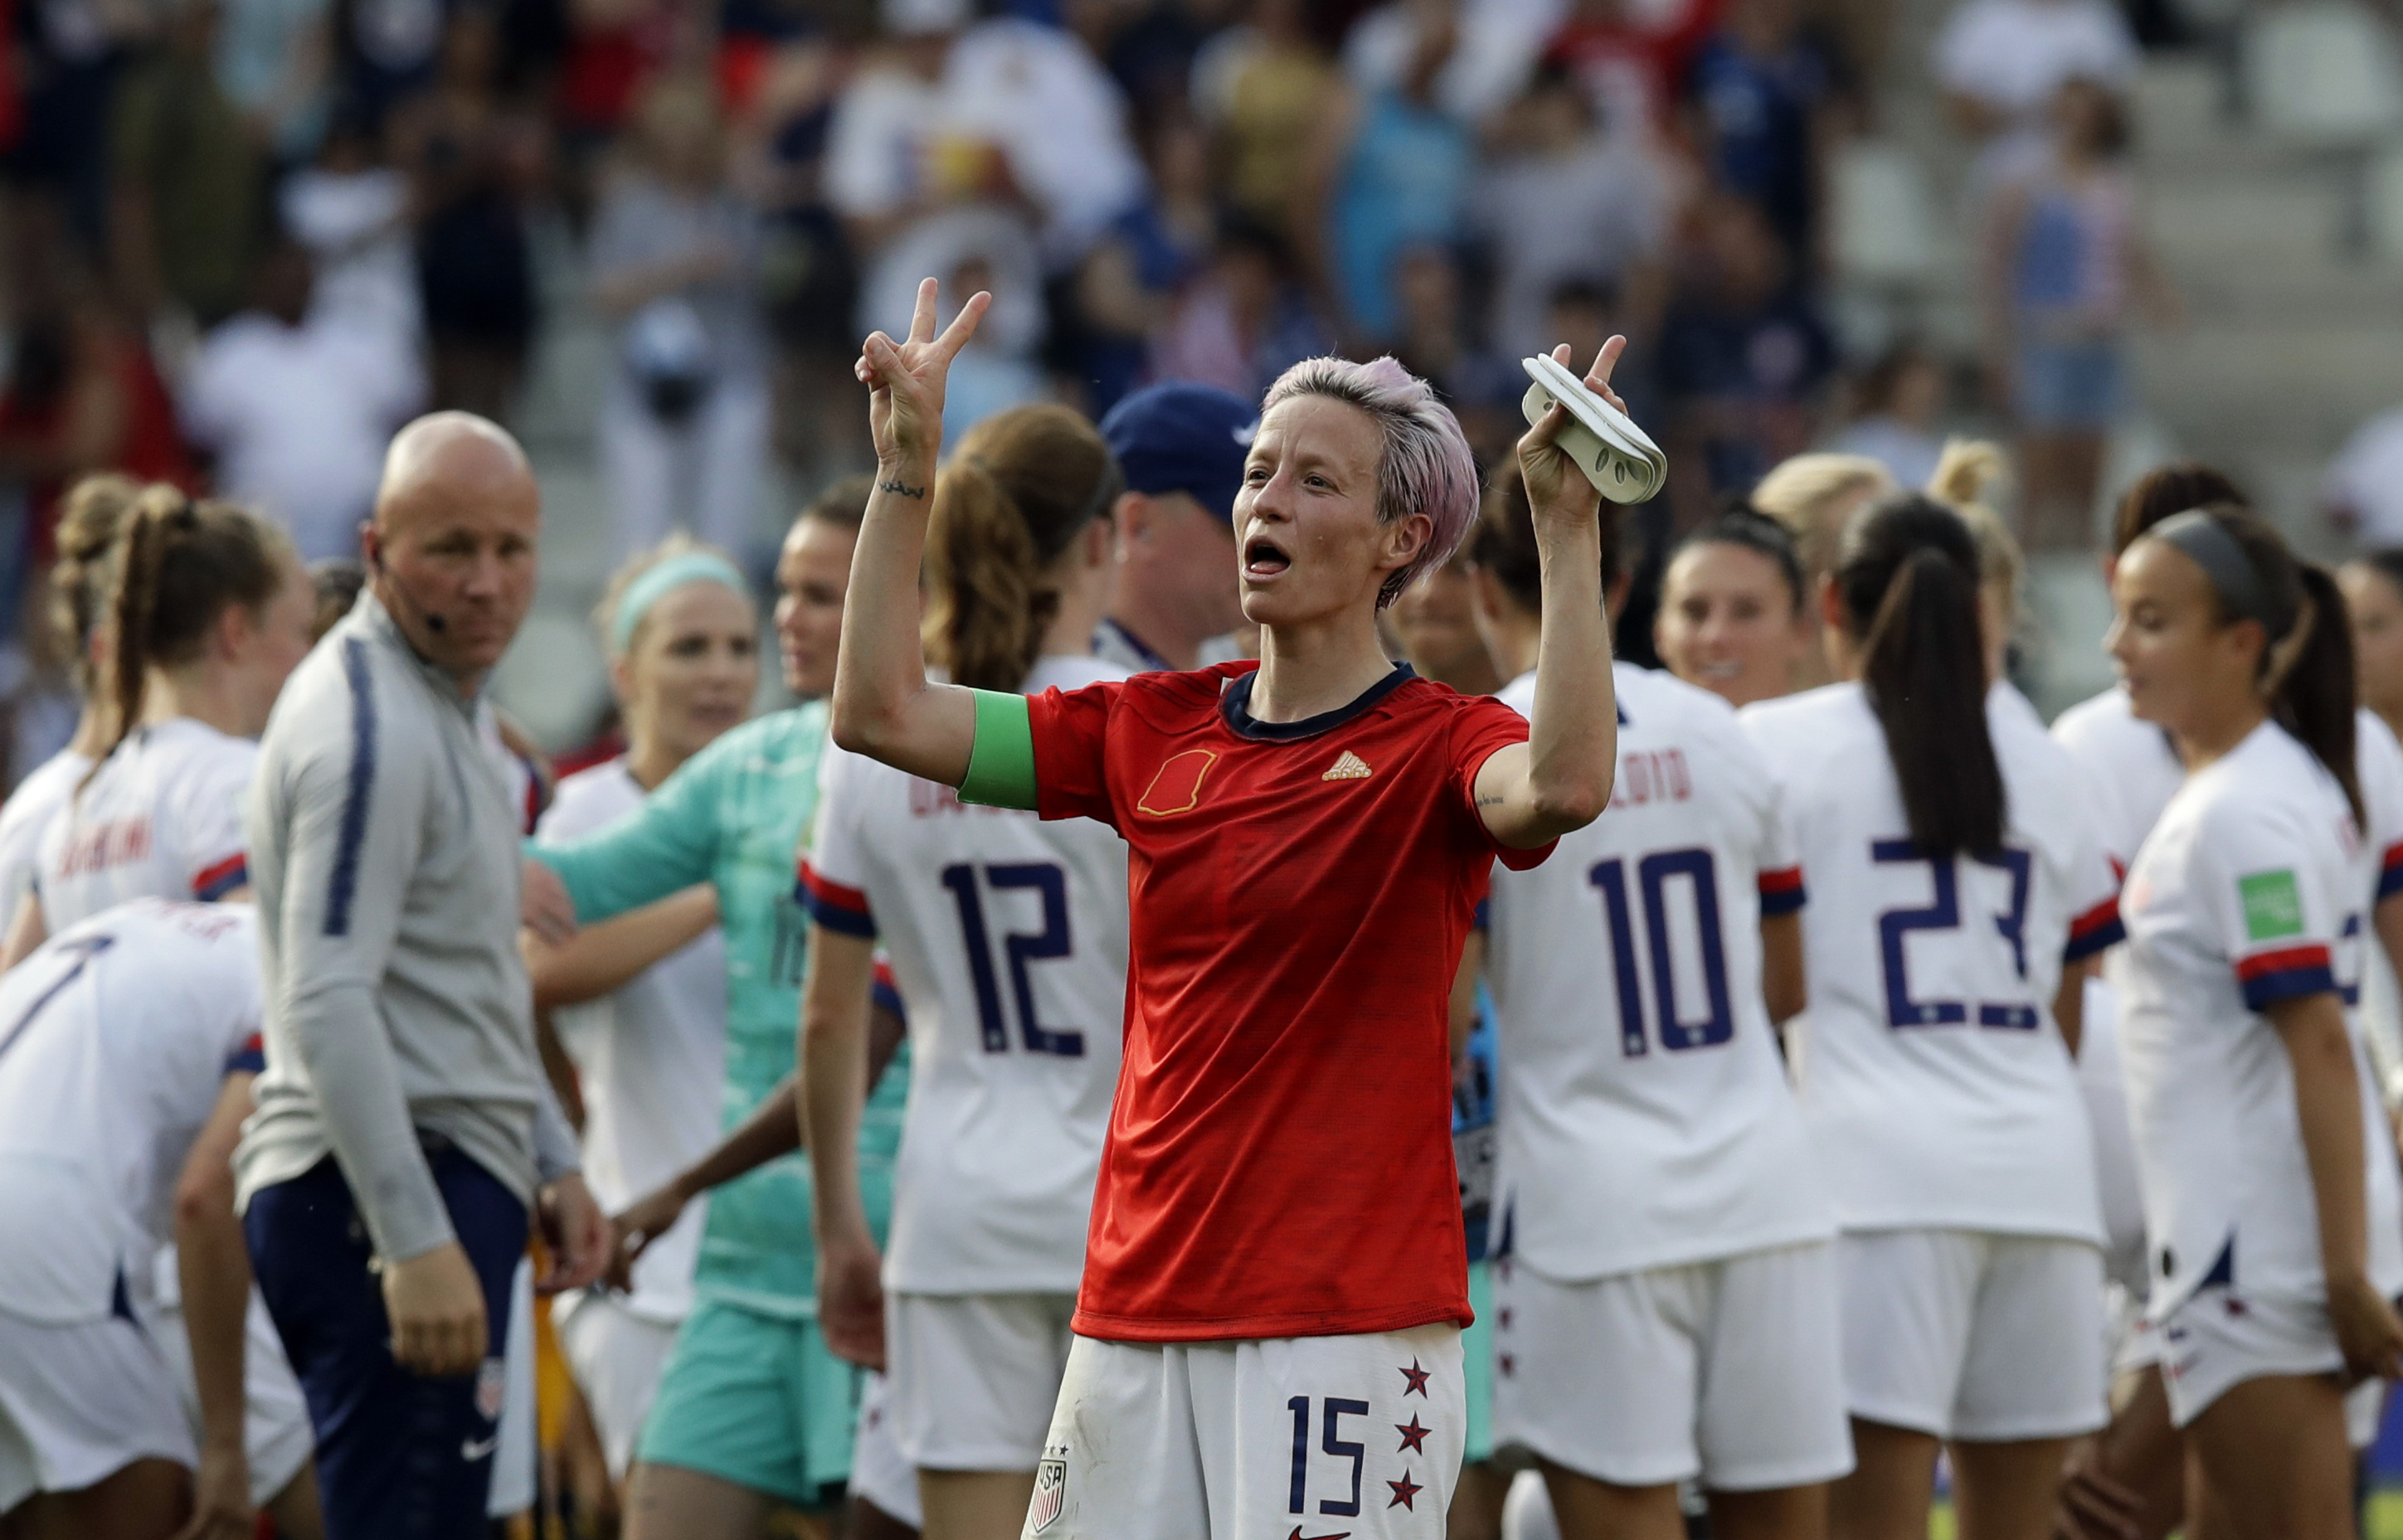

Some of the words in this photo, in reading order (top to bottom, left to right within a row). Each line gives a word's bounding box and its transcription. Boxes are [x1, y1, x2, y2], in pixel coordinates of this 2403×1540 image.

[942, 862, 1084, 1056] 12
[1588, 848, 1734, 1057] 10
[1872, 839, 2038, 1029] 23
[1039, 1465, 1063, 1491] USA
[1287, 1396, 1369, 1518] 15
